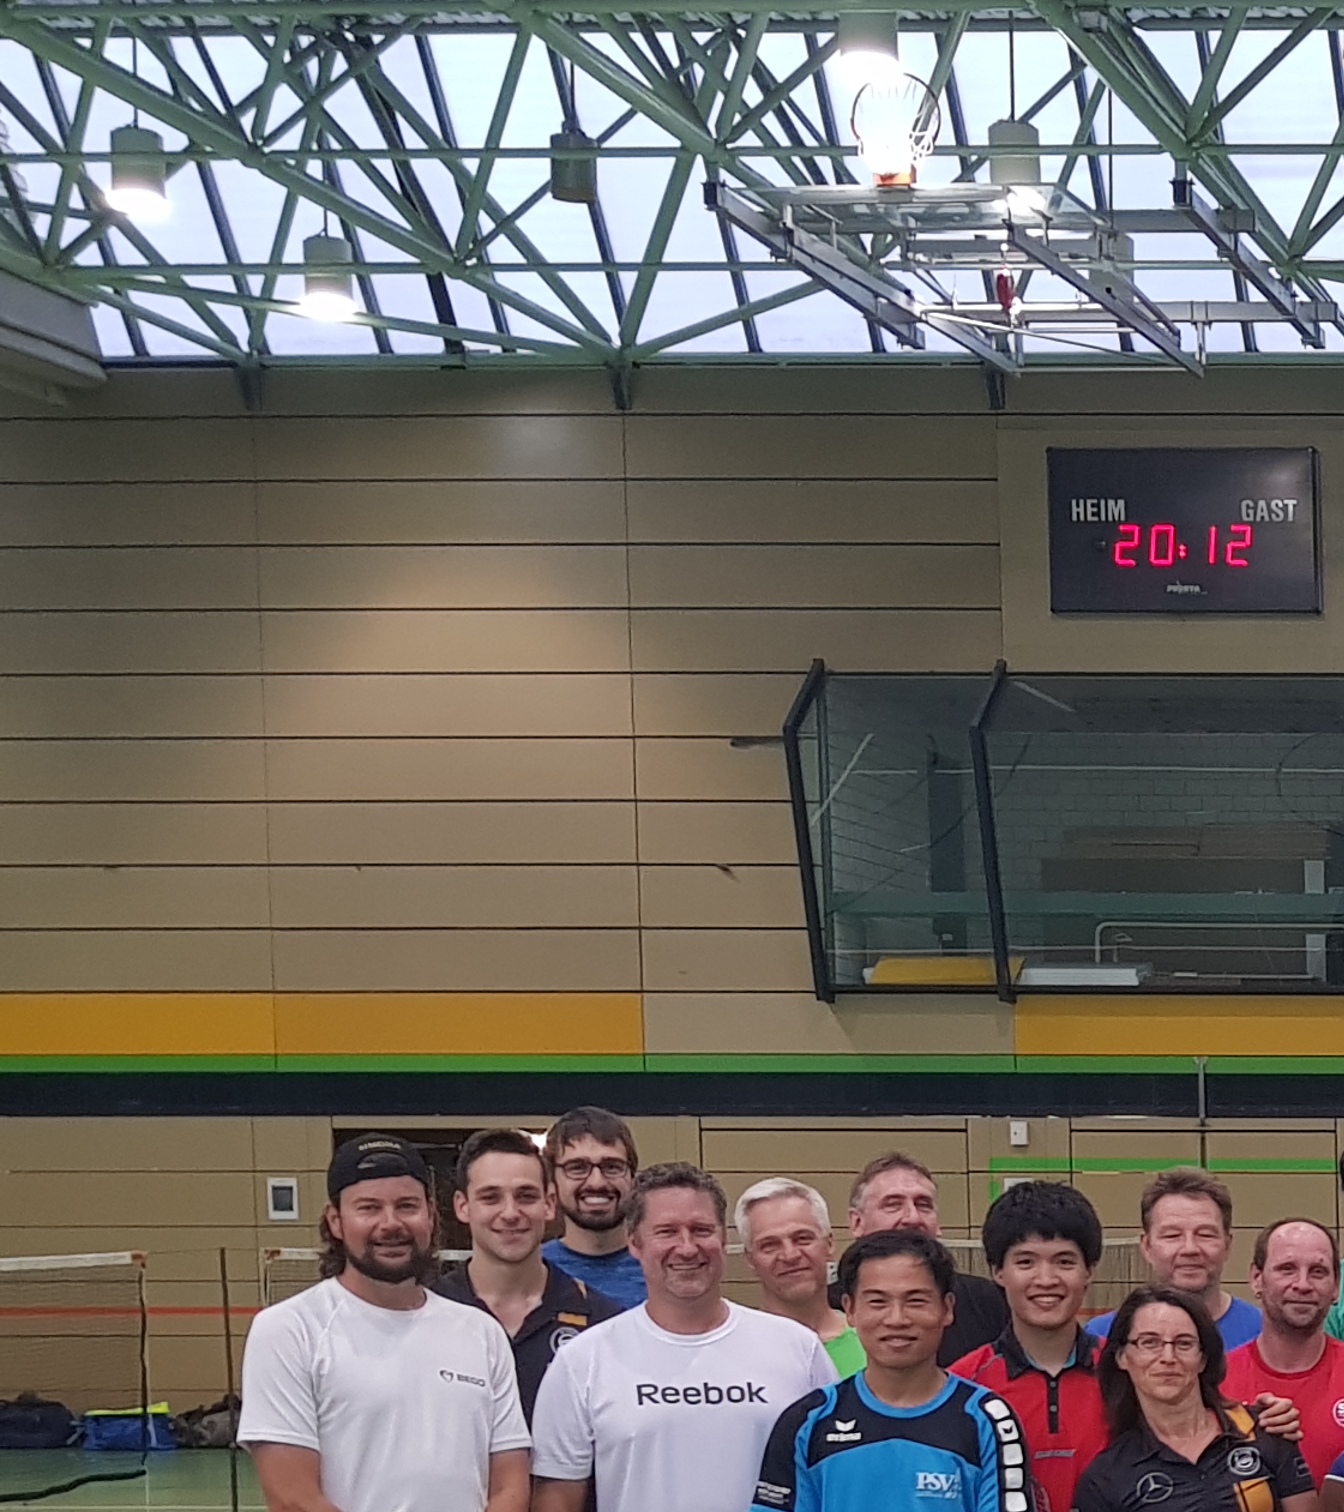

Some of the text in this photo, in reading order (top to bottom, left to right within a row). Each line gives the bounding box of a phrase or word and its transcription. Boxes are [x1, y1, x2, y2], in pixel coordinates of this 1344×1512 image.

[1071, 499, 1126, 522] HEIM
[1240, 499, 1298, 522] GAST
[636, 1381, 769, 1406] Reebok
[915, 1472, 955, 1491] PSV
